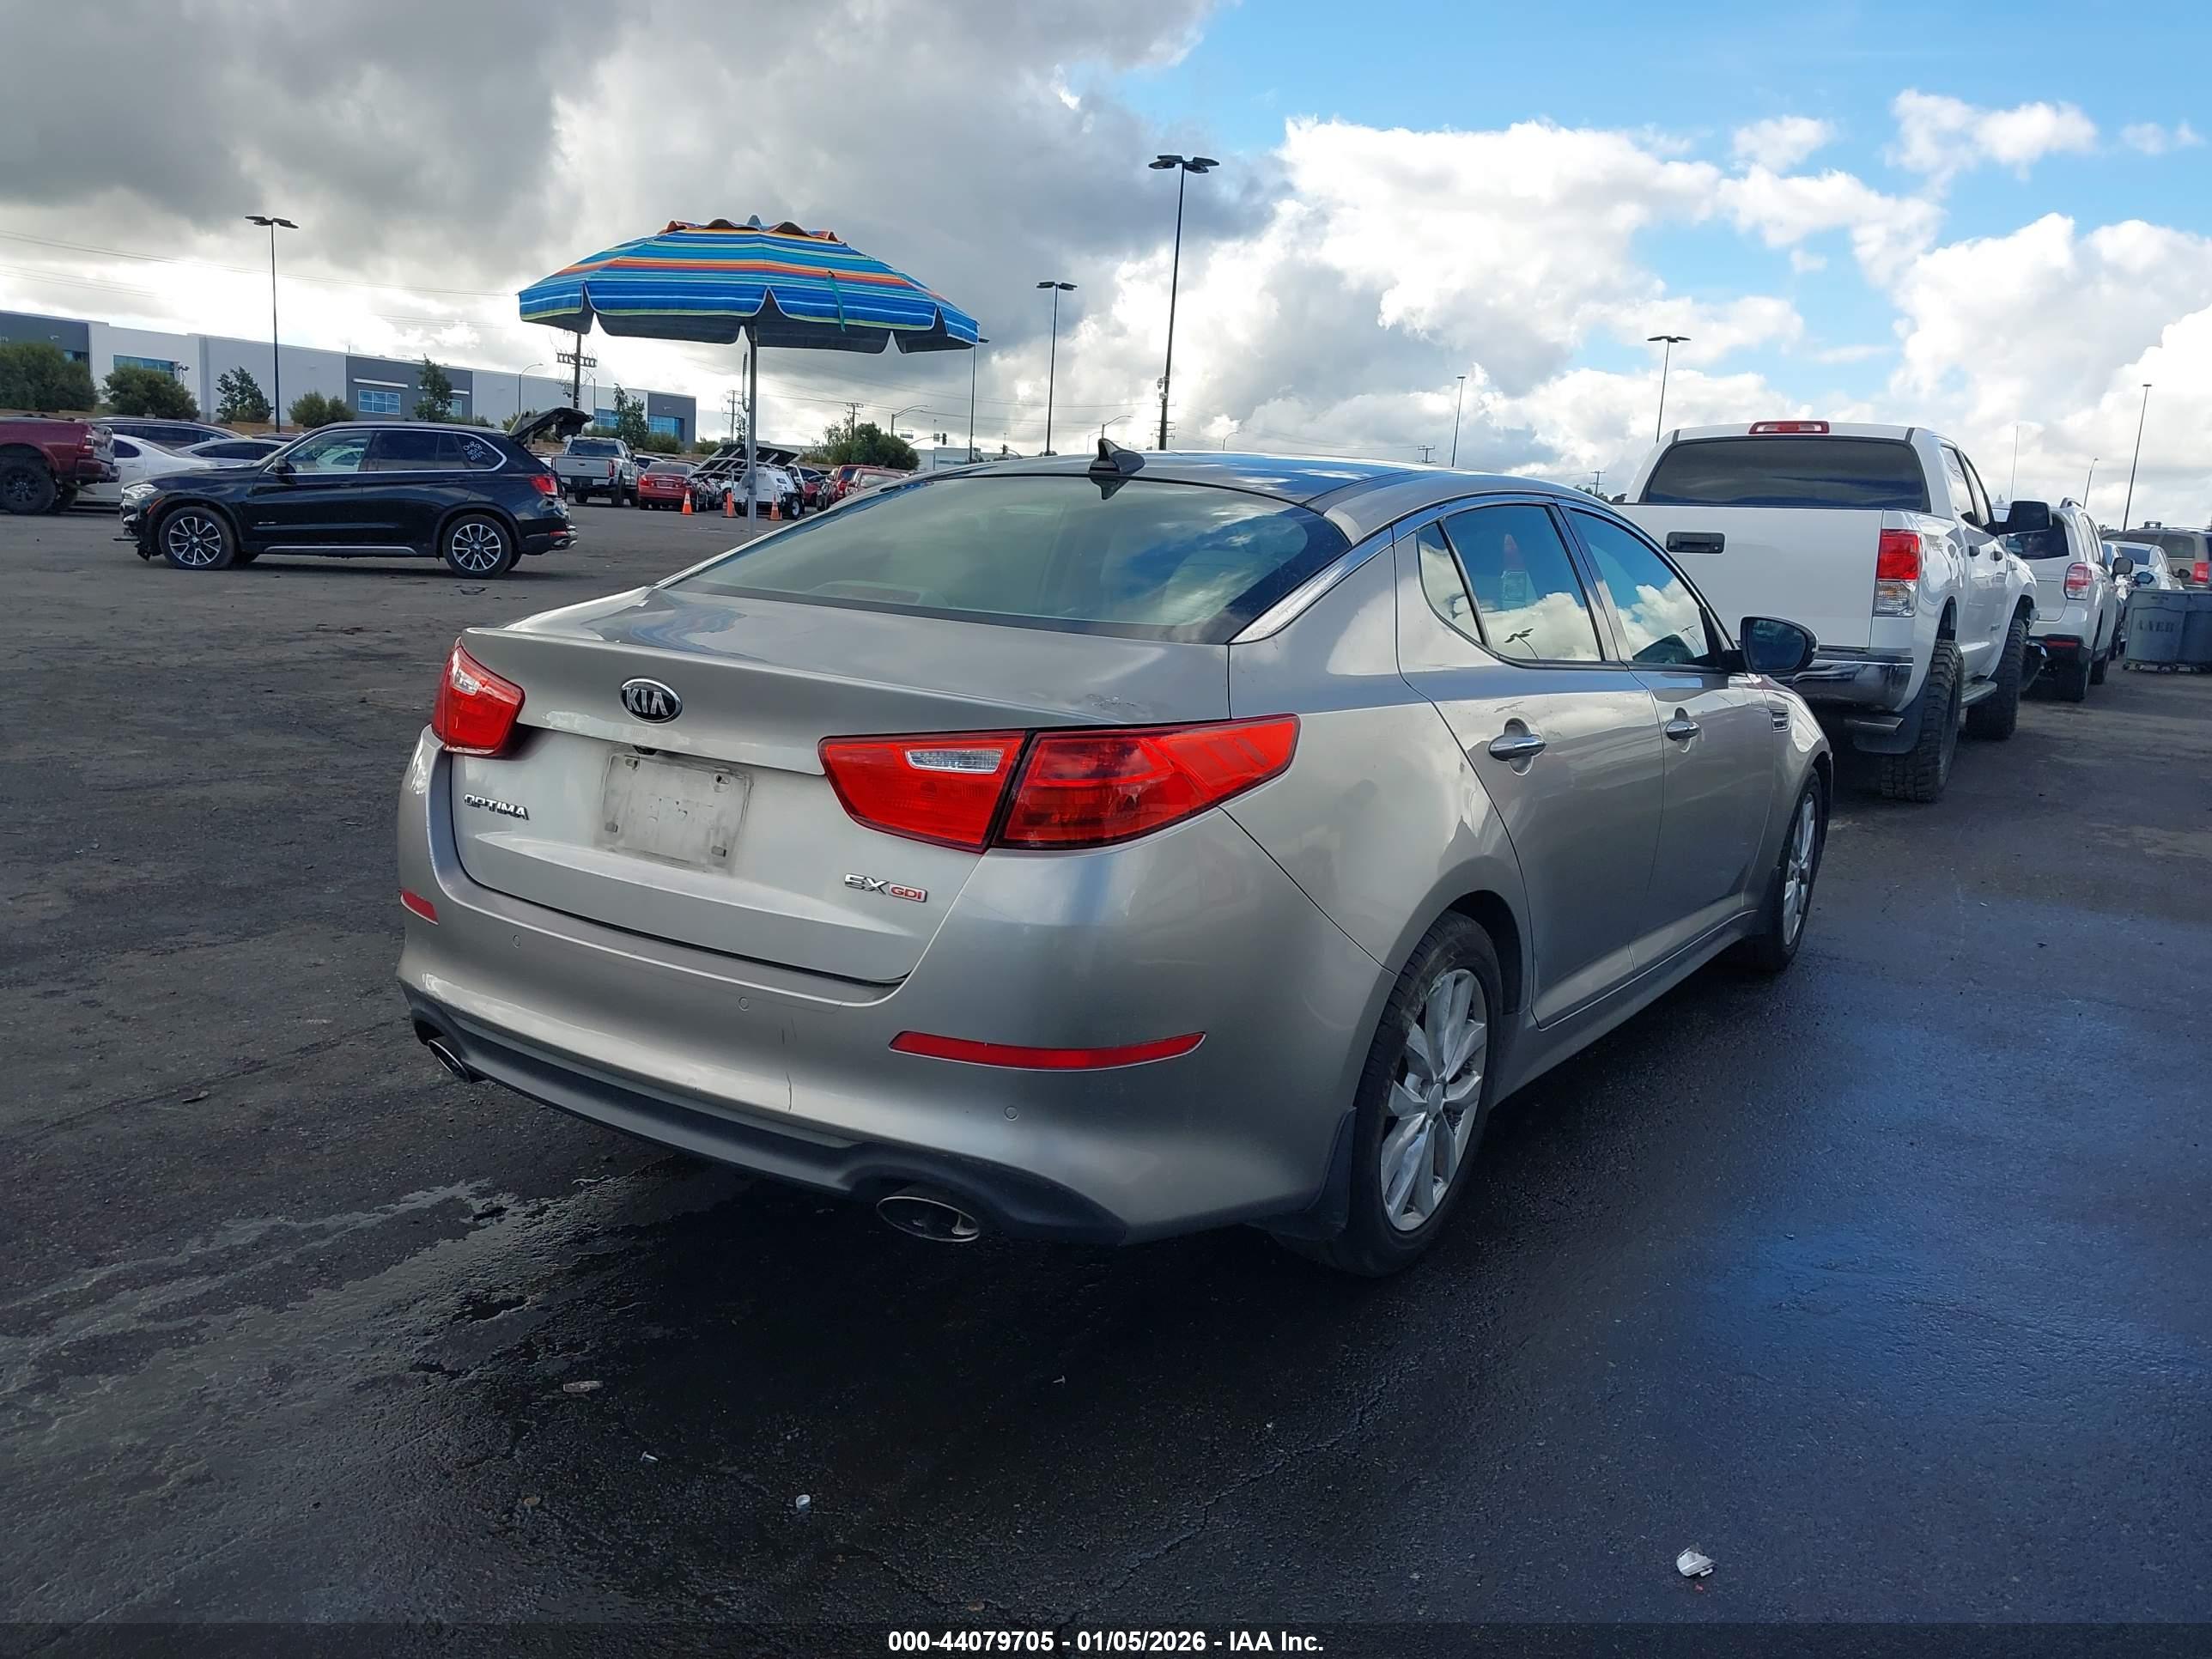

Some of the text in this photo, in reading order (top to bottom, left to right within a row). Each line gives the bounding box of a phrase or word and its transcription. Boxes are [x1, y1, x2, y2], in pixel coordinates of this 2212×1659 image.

[626, 687, 669, 715] KIA
[465, 793, 529, 820] OPTIMA
[844, 873, 923, 900] EX GDI
